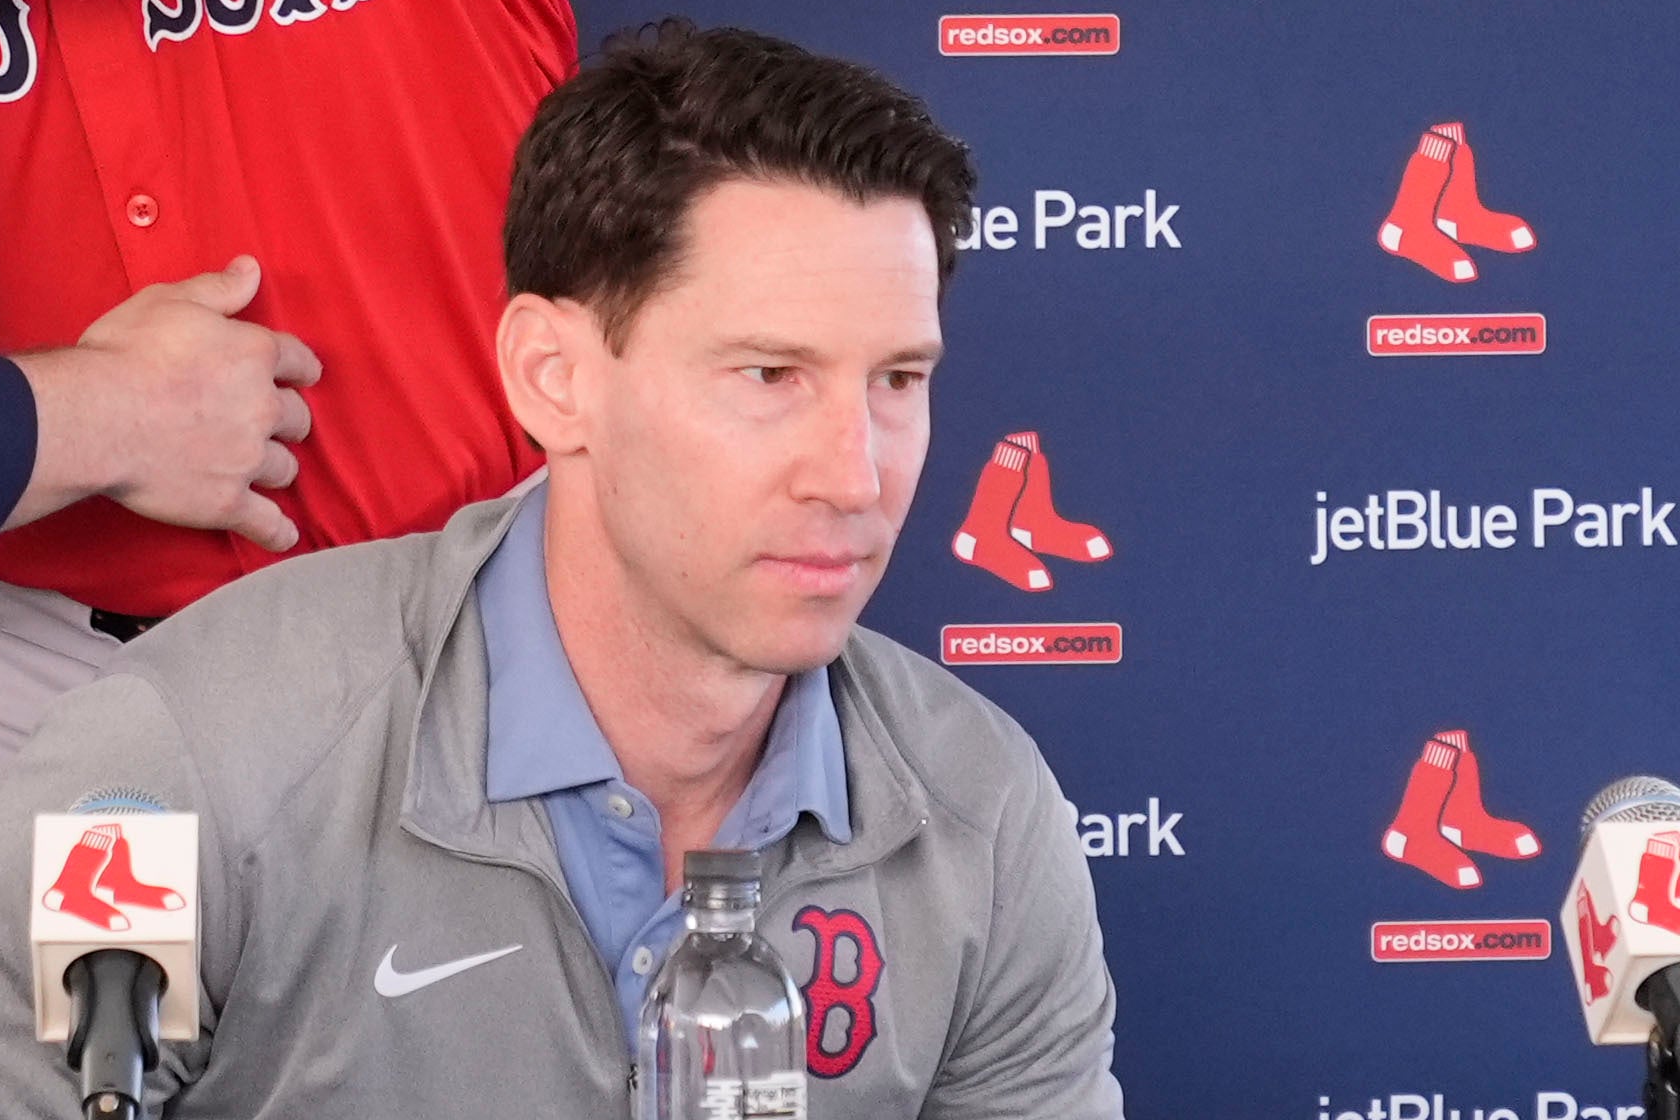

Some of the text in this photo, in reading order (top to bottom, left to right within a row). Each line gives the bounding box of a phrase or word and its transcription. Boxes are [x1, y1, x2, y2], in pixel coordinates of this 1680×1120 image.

[948, 24, 1110, 45] redsox.com
[1035, 189, 1181, 249] Park
[1377, 324, 1537, 345] redsox.com
[1311, 487, 1677, 564] jetBlue Park
[951, 633, 1113, 654] redsox.com
[1064, 797, 1186, 857] ark
[1381, 930, 1542, 951] redsox.com
[792, 904, 886, 1079] B
